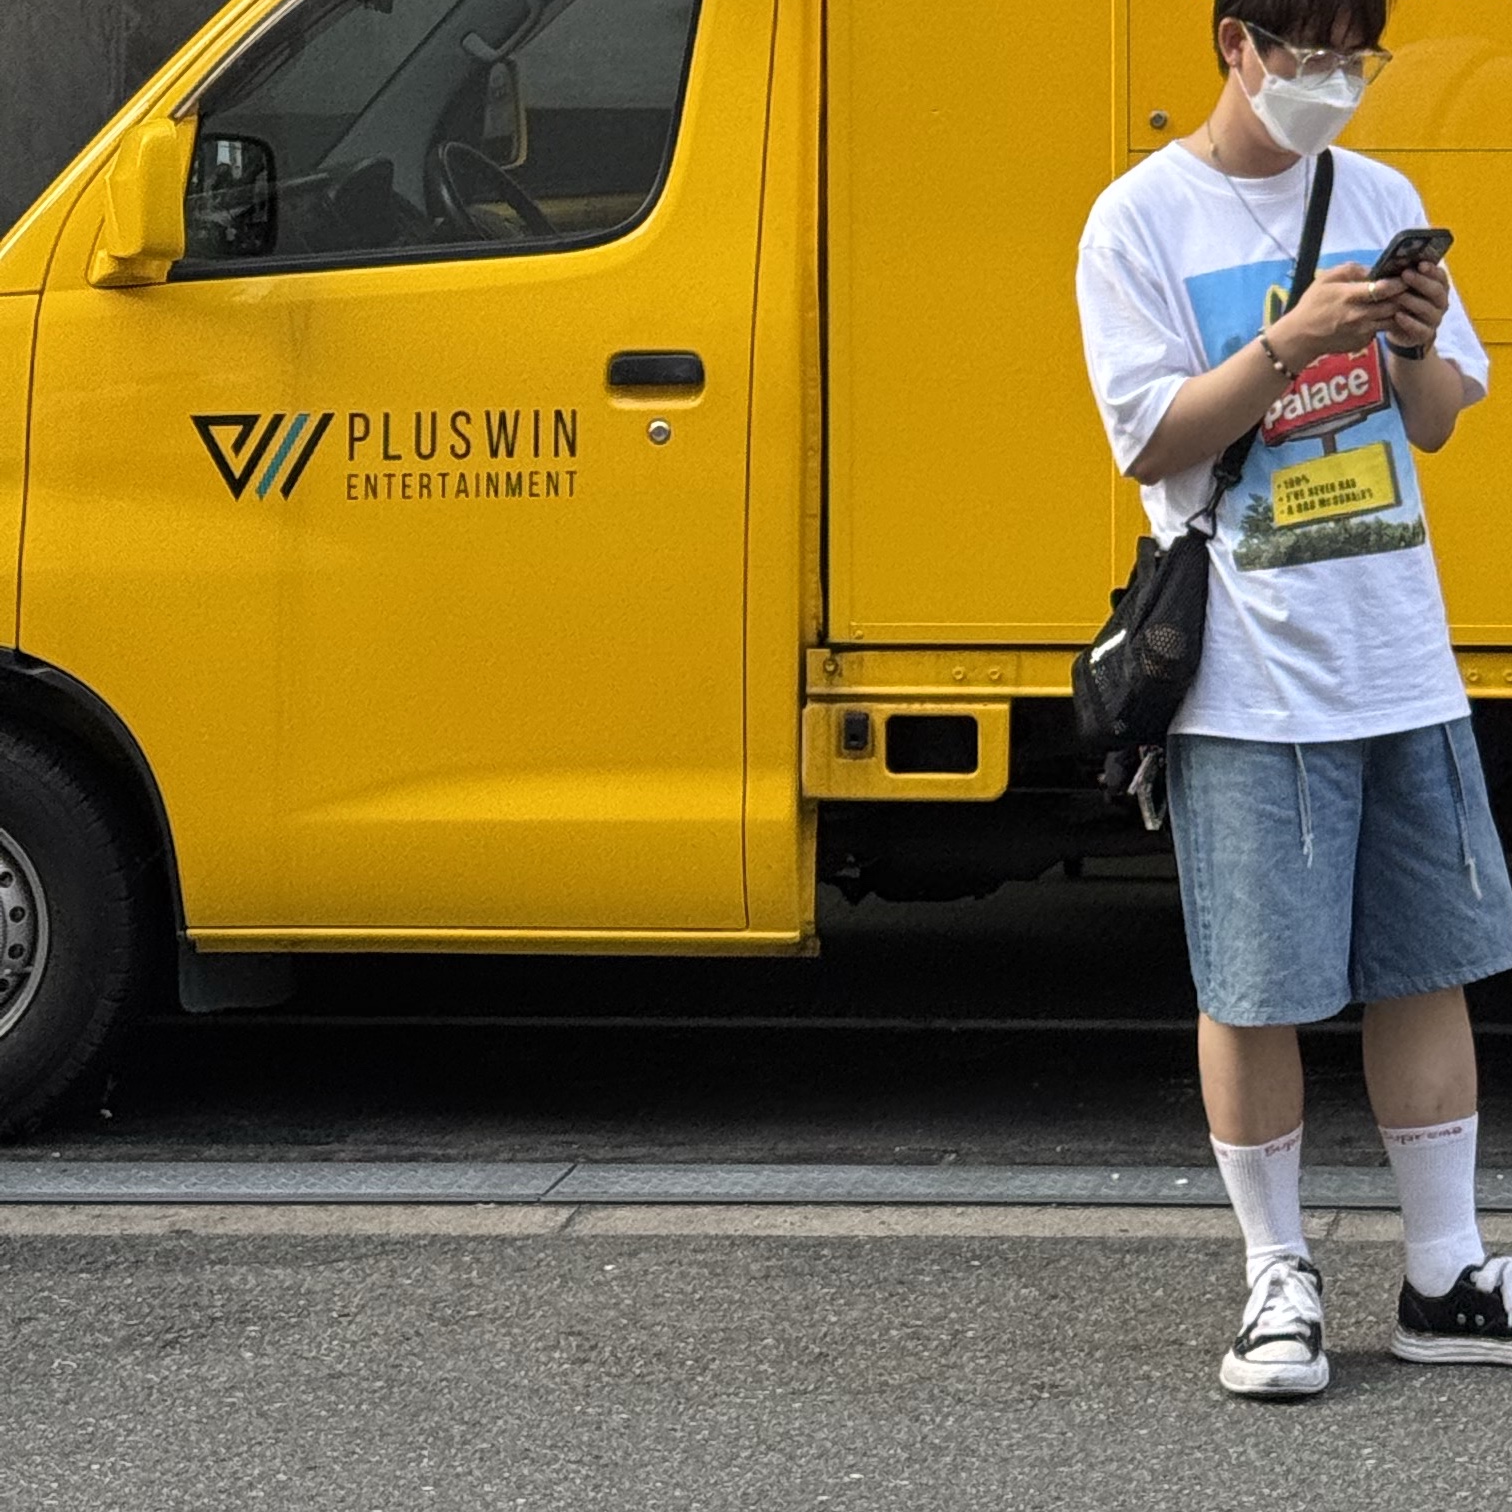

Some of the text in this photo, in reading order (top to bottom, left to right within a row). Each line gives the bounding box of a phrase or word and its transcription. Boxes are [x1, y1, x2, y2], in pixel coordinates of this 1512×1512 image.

[1264, 367, 1369, 430] Palace
[347, 408, 578, 462] PLUSWIN
[345, 469, 578, 501] ENTERTAINMENT
